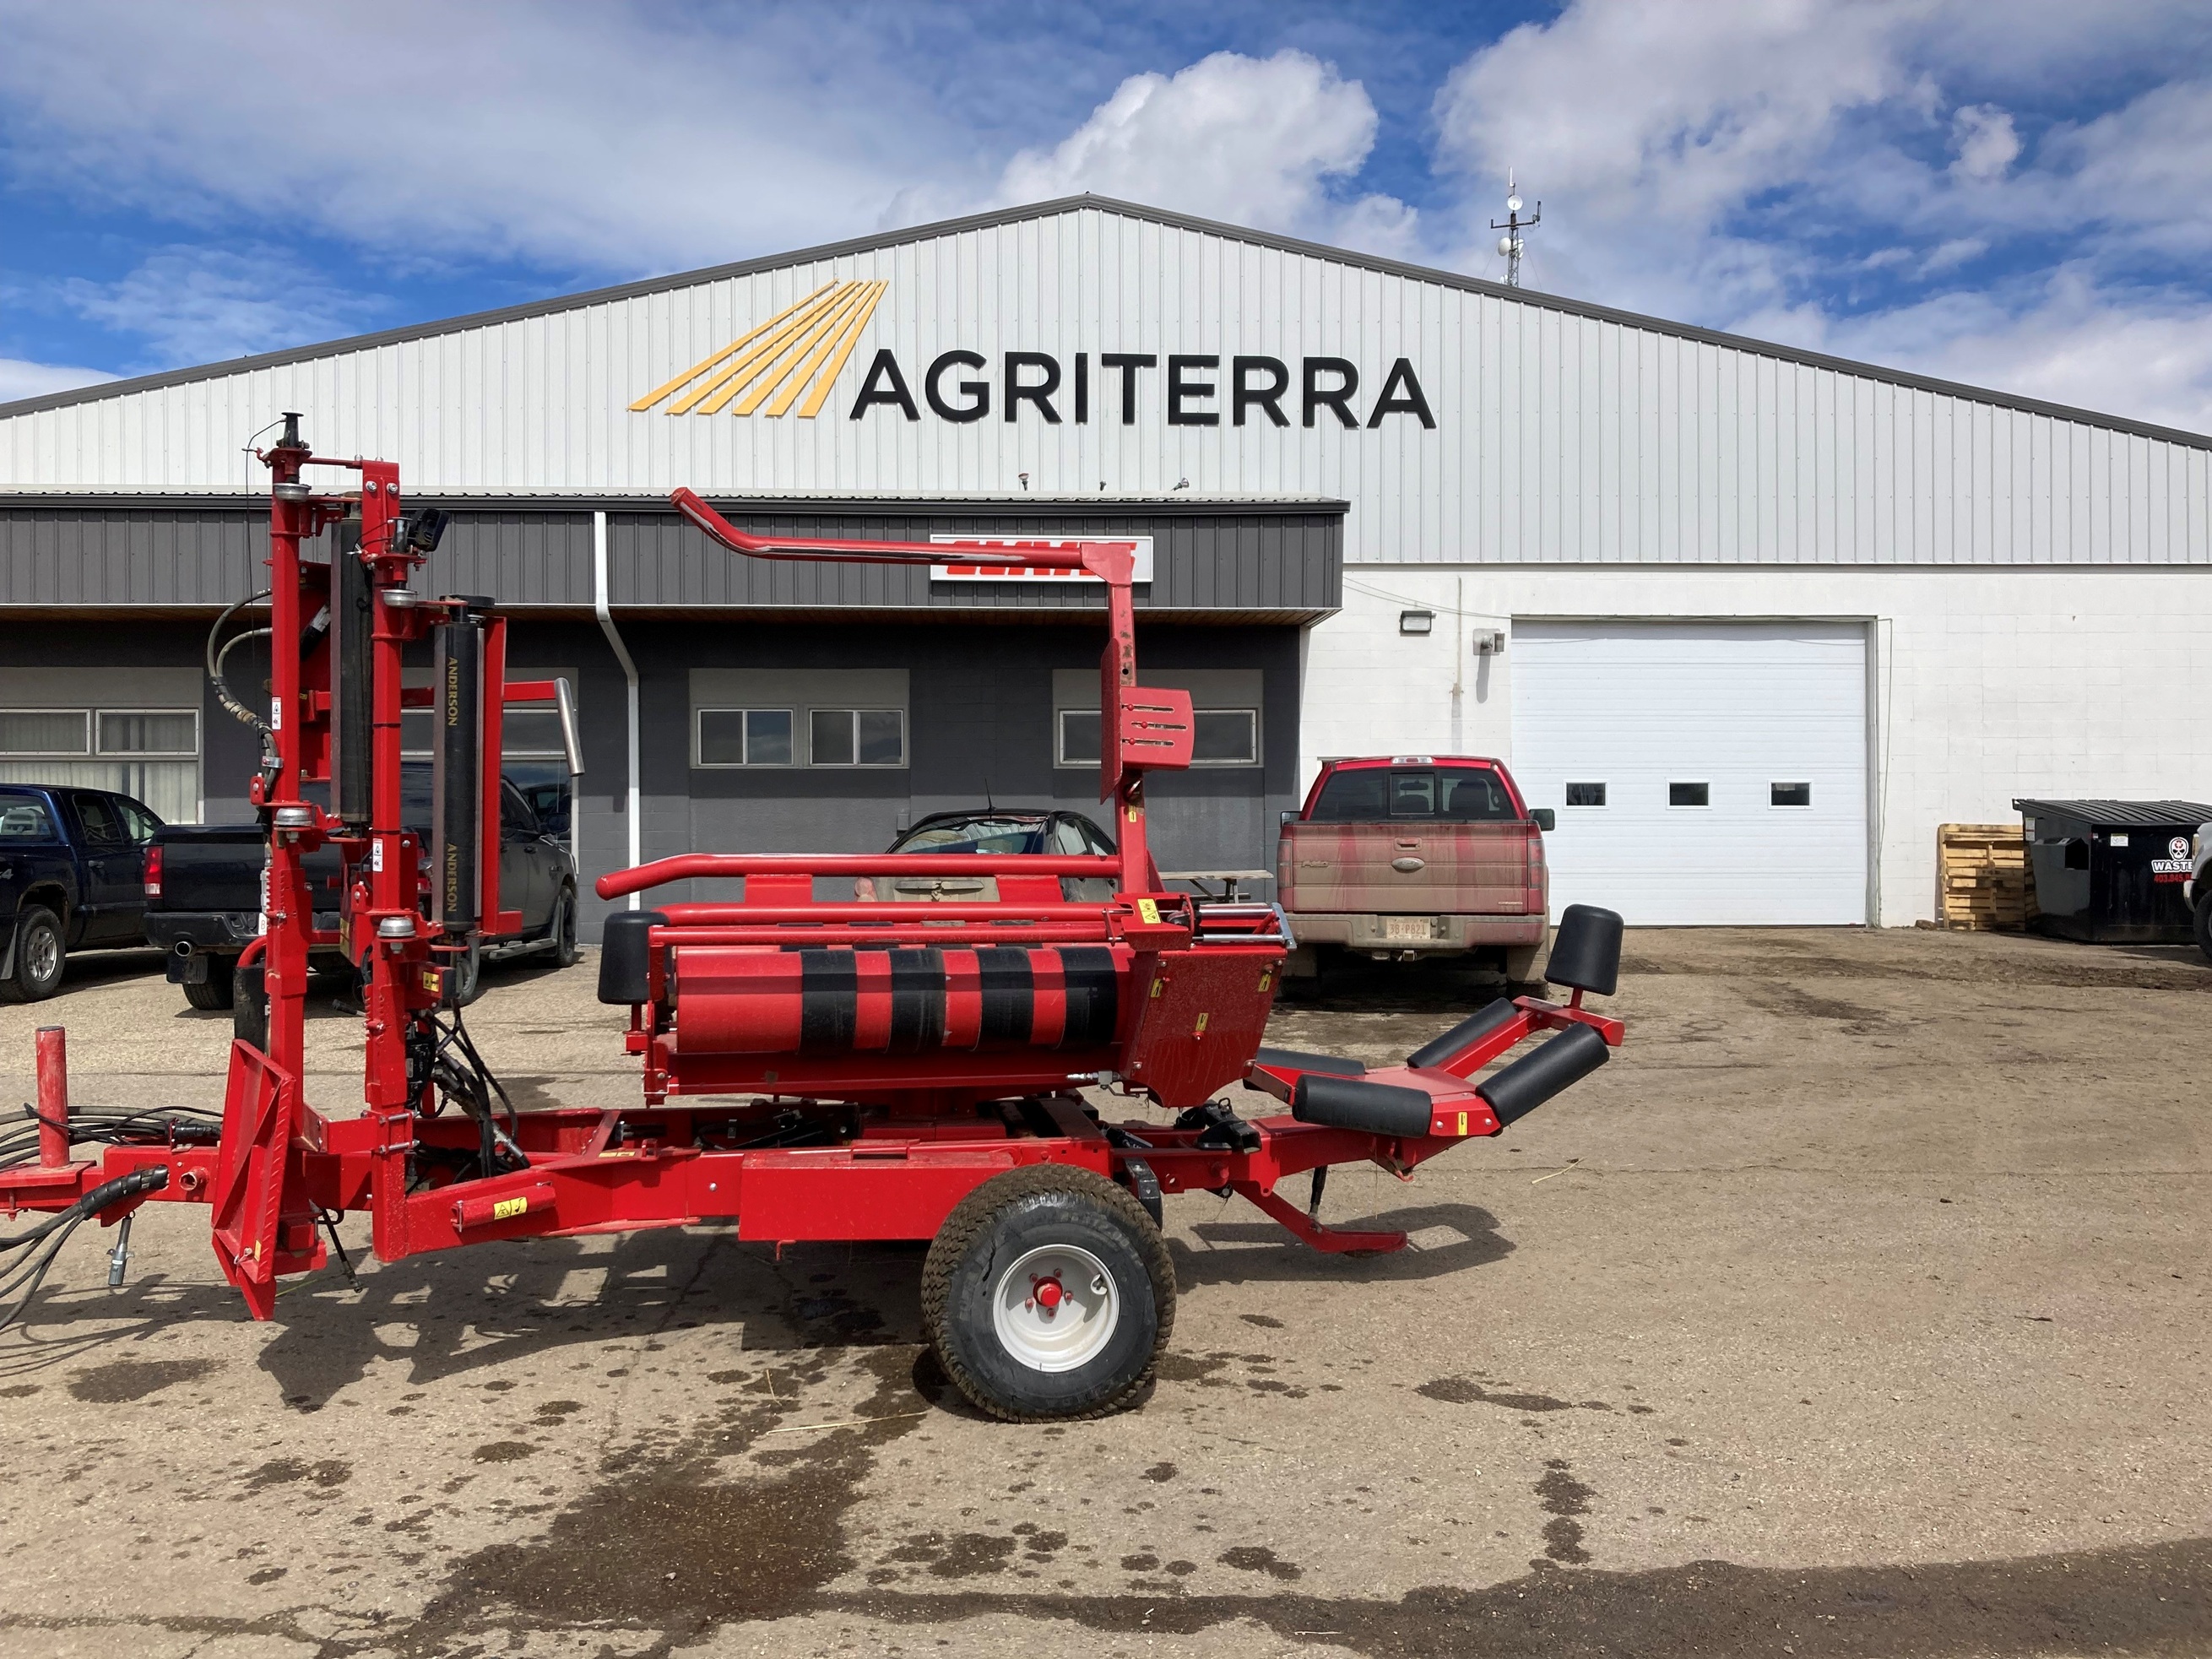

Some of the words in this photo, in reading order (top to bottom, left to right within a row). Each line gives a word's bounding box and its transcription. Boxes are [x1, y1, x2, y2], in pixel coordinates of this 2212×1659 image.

[849, 349, 1437, 430] AGRITERRA
[447, 657, 458, 726] ANDERSON
[447, 843, 458, 912] ANDERSON
